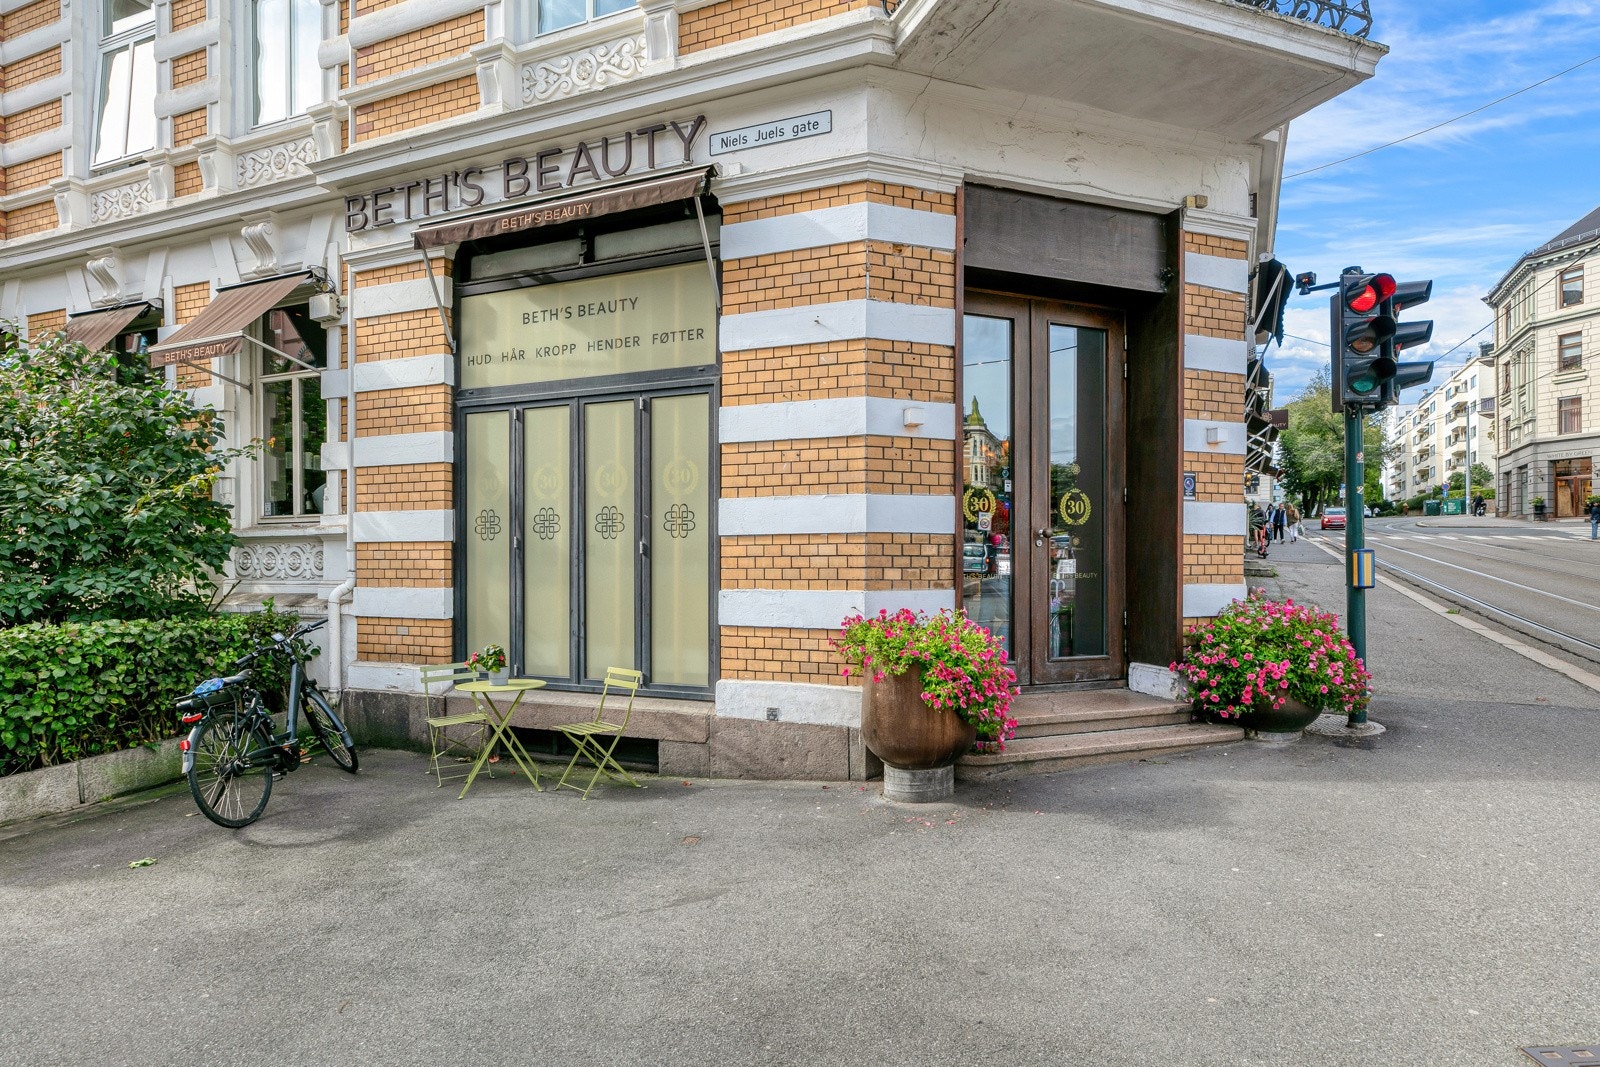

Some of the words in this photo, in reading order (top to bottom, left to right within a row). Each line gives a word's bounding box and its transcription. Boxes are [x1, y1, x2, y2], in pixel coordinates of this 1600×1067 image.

[720, 133, 748, 149] Niels
[754, 126, 785, 142] Juels
[792, 120, 820, 137] gate
[344, 165, 485, 233] BETH'S
[502, 114, 706, 200] BEAUTY
[501, 210, 543, 230] BETH'S
[544, 202, 593, 223] BEAUTY
[522, 306, 573, 325] BETH'S
[577, 296, 639, 318] BEAUTY
[165, 350, 192, 362] BETH'S
[194, 344, 226, 357] BEAUTY
[467, 354, 492, 367] HUD
[501, 348, 526, 362] HÅR
[535, 343, 577, 359] KROPP
[587, 336, 640, 352] HENDER
[652, 328, 705, 344] FØTTER
[970, 496, 989, 512] 30
[1067, 500, 1085, 514] 30
